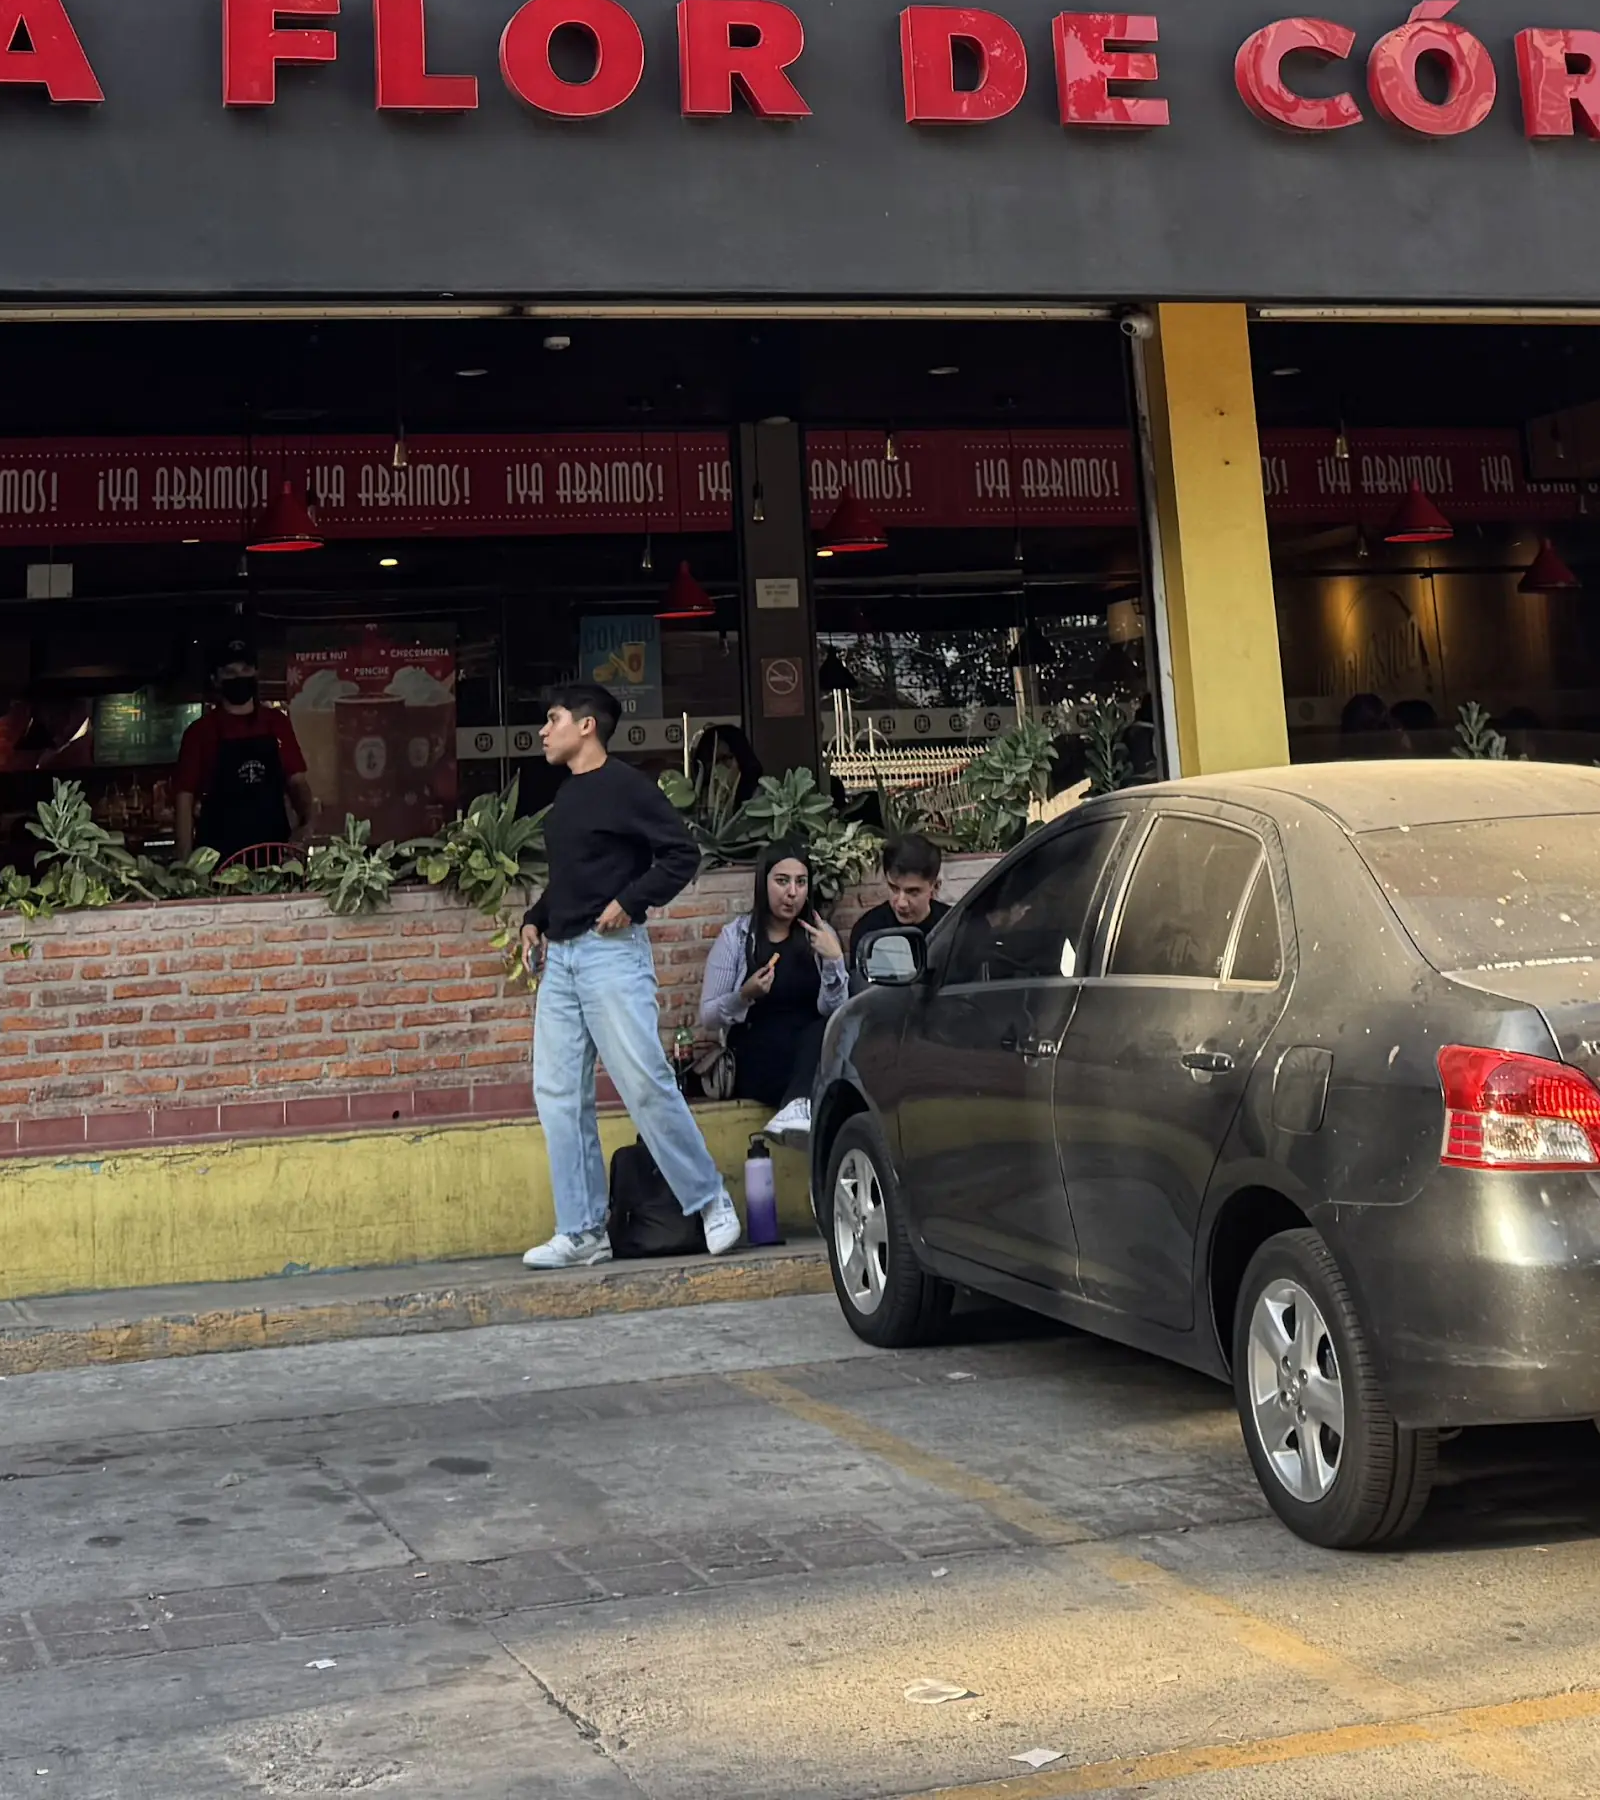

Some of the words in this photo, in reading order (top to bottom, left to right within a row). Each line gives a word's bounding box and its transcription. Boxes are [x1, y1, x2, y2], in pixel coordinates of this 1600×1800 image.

[899, 4, 1171, 128] DE
[97, 467, 139, 512] ¡YA
[151, 465, 268, 511] ABRIMOS!
[357, 463, 471, 507] ABRIMOS!
[506, 462, 544, 505] ¡YA
[556, 461, 664, 504] ABRIMOS!
[975, 458, 1010, 499] ¡YA
[1020, 457, 1120, 499] ABRIMOS!
[1480, 456, 1515, 494] ¡YA
